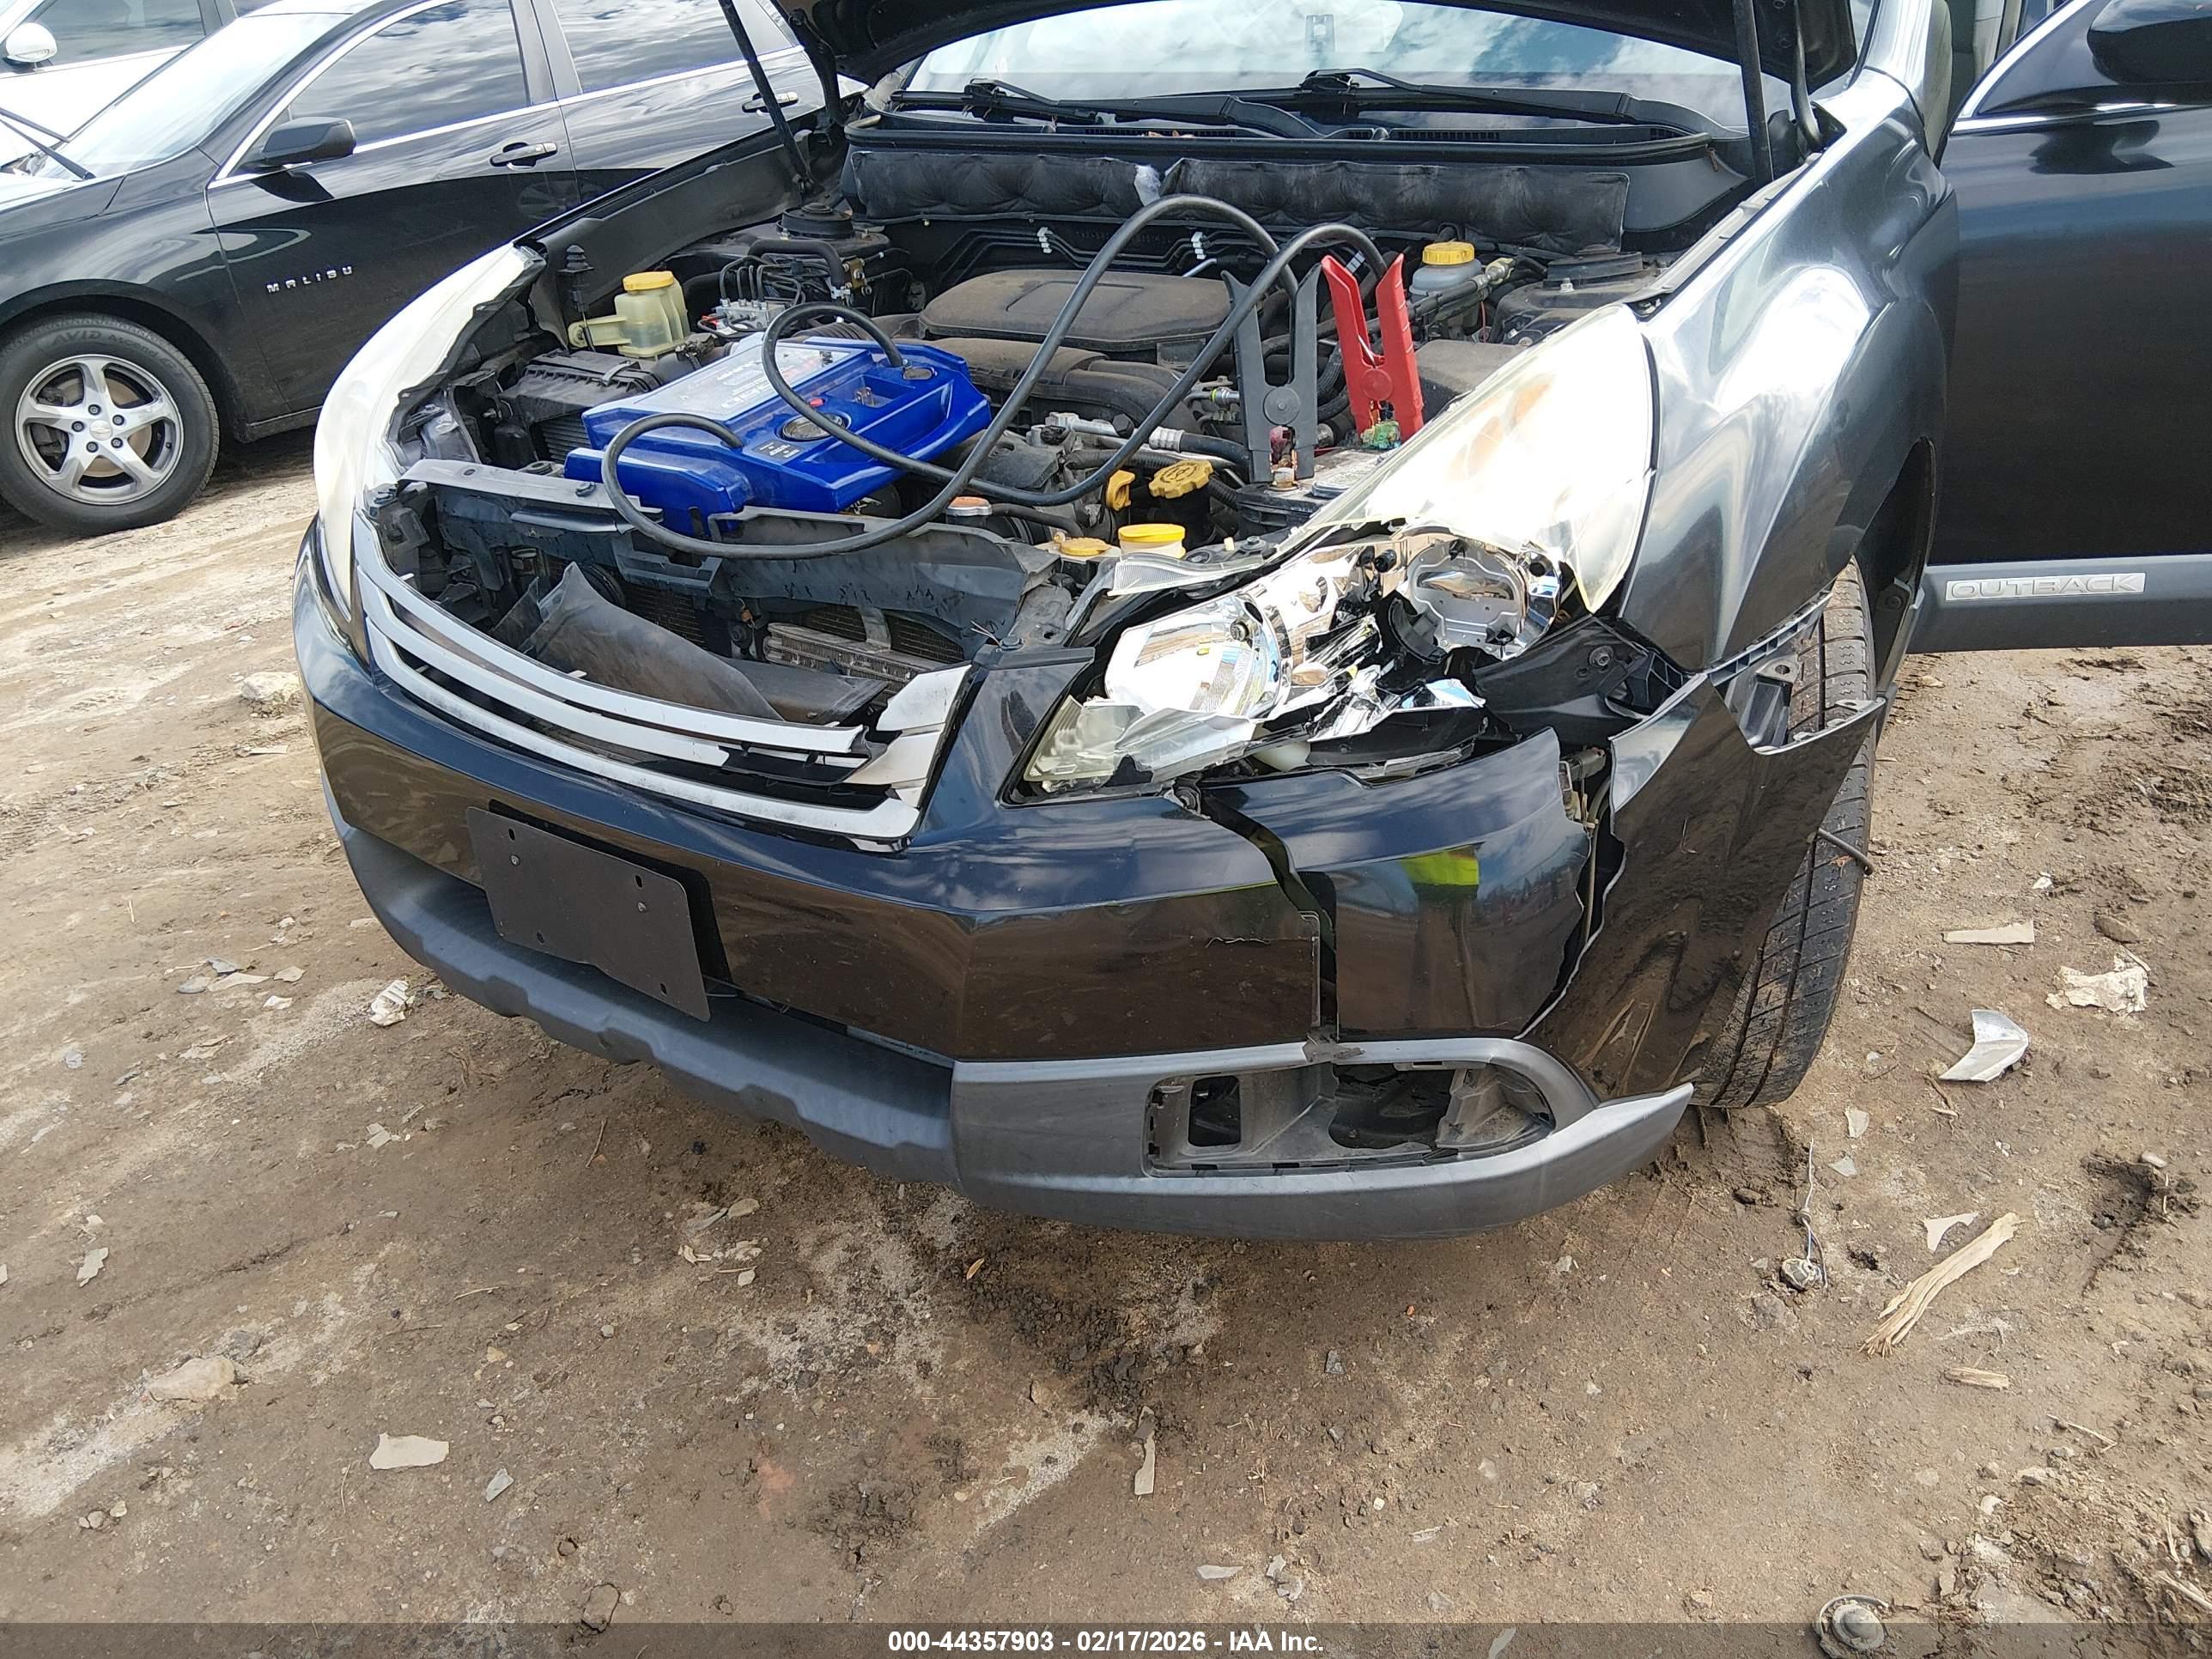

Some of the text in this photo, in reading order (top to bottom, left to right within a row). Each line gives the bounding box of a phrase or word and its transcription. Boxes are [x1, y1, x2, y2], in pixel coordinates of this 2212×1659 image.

[265, 265, 353, 294] MALIBU
[52, 330, 102, 345] AVID
[1950, 574, 2138, 599] OUTBACK
